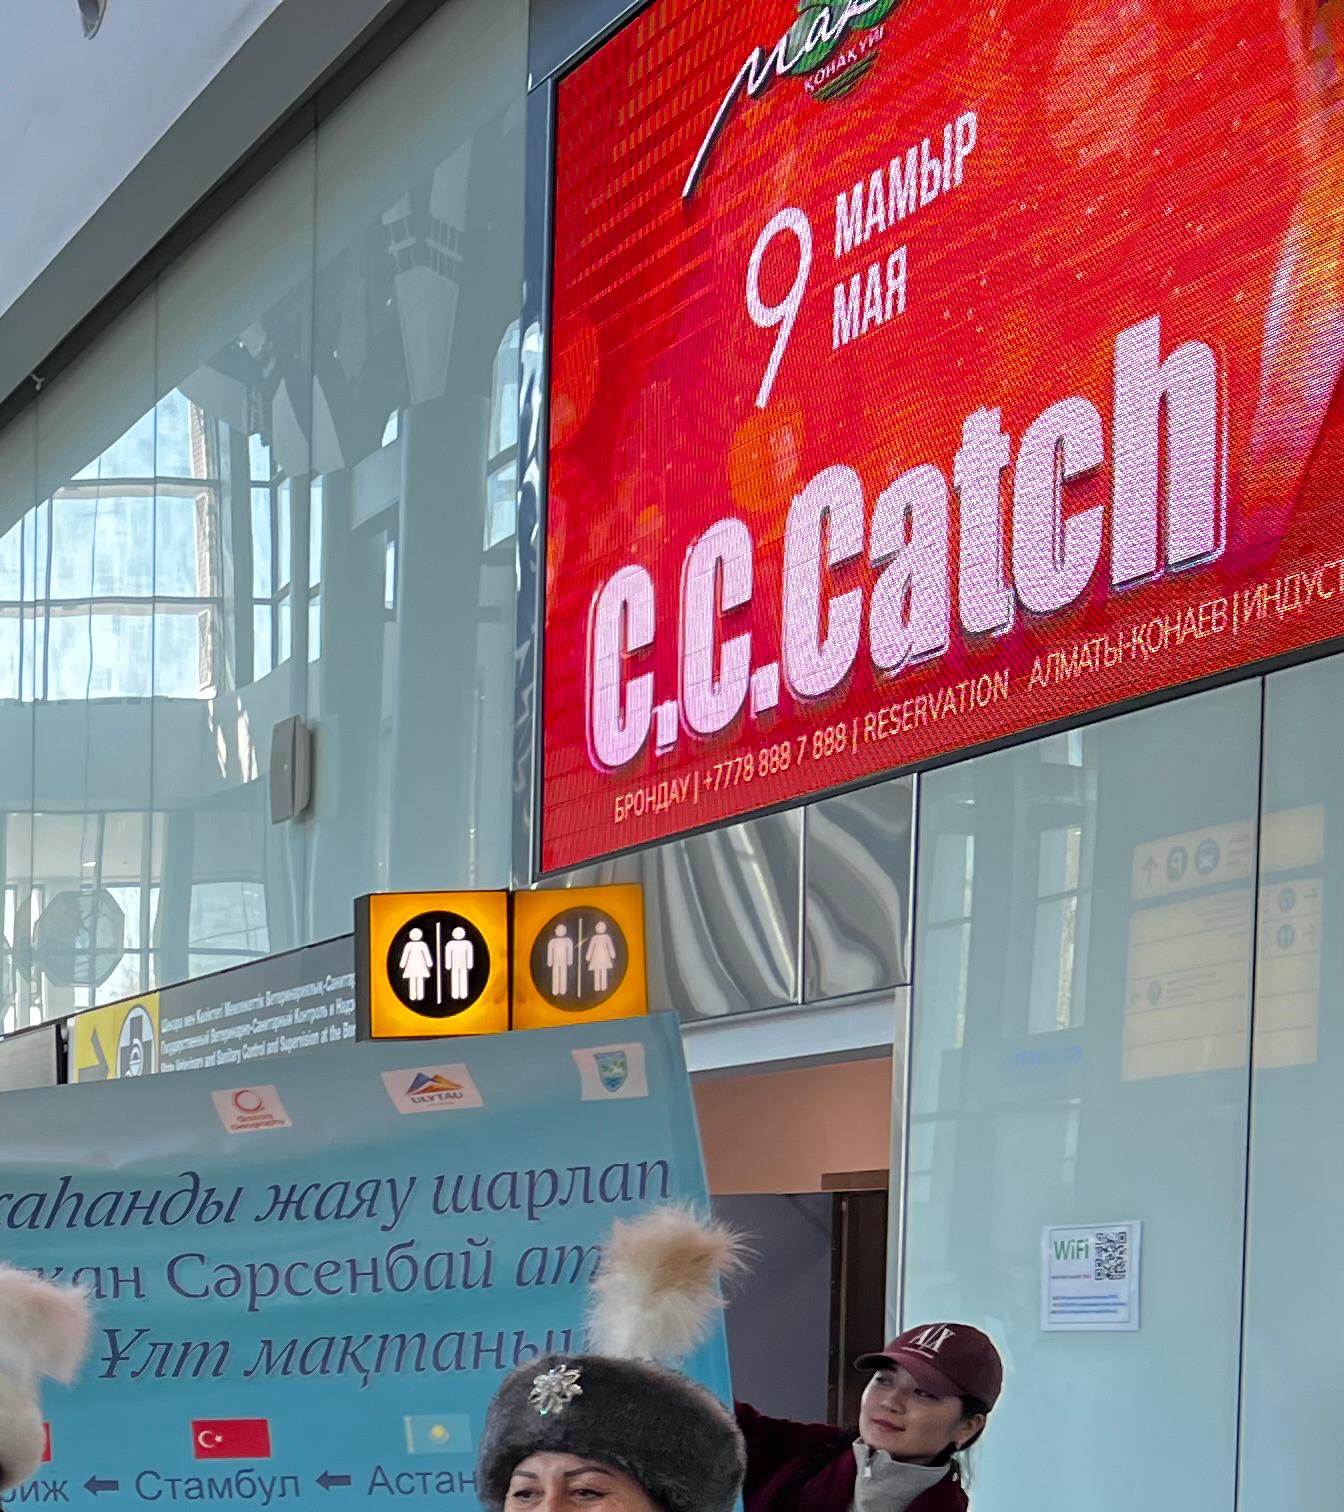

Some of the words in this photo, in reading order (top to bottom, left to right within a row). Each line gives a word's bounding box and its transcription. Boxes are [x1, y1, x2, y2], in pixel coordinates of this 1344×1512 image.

[834, 110, 978, 259] МАМЫР
[745, 206, 813, 410] 9
[832, 245, 908, 351] МАЯ
[585, 313, 1230, 775] C.C.Catch
[613, 776, 690, 824] БРОНДАУ
[703, 758, 754, 797] +7778
[757, 739, 792, 778] 888
[796, 736, 806, 766] 7
[812, 721, 847, 761] 888
[862, 669, 1010, 744] RESERVATION
[410, 1091, 464, 1104] ULYTAU
[254, 1173, 417, 1232] жаяу
[433, 1158, 671, 1222] шарлап
[166, 1236, 494, 1313] Сәрсенбай
[515, 1244, 603, 1288] ат
[1053, 1237, 1089, 1261] WiFi
[98, 1328, 231, 1381] Ұлт
[243, 1327, 573, 1390] мақтаны
[133, 1467, 301, 1506] Стамбул
[367, 1465, 478, 1498] Астан
